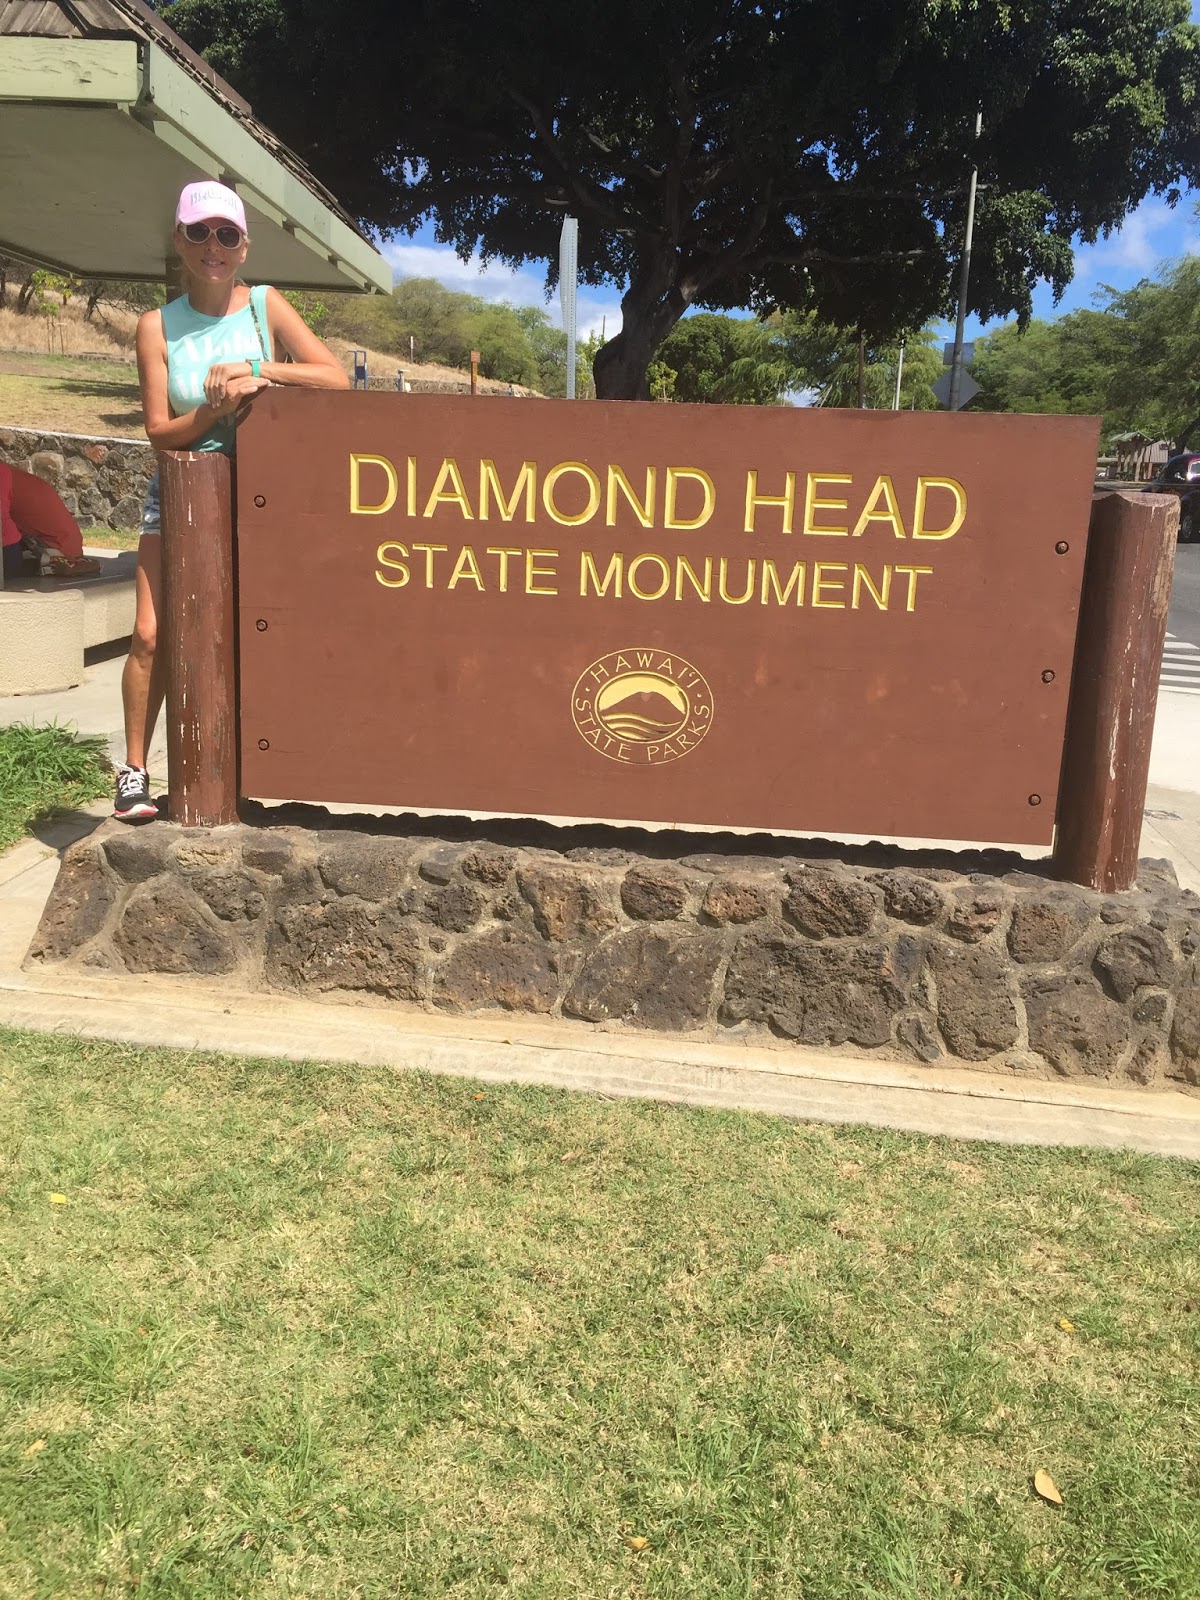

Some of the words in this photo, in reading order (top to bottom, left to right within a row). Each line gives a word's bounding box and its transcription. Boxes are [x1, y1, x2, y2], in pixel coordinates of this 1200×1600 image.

[349, 453, 717, 530] DIAMOND
[743, 470, 968, 541] HEAD
[374, 540, 560, 596] STATE
[579, 550, 934, 612] MONUMENT
[575, 698, 632, 760] STATE
[646, 704, 710, 761] PARKS
